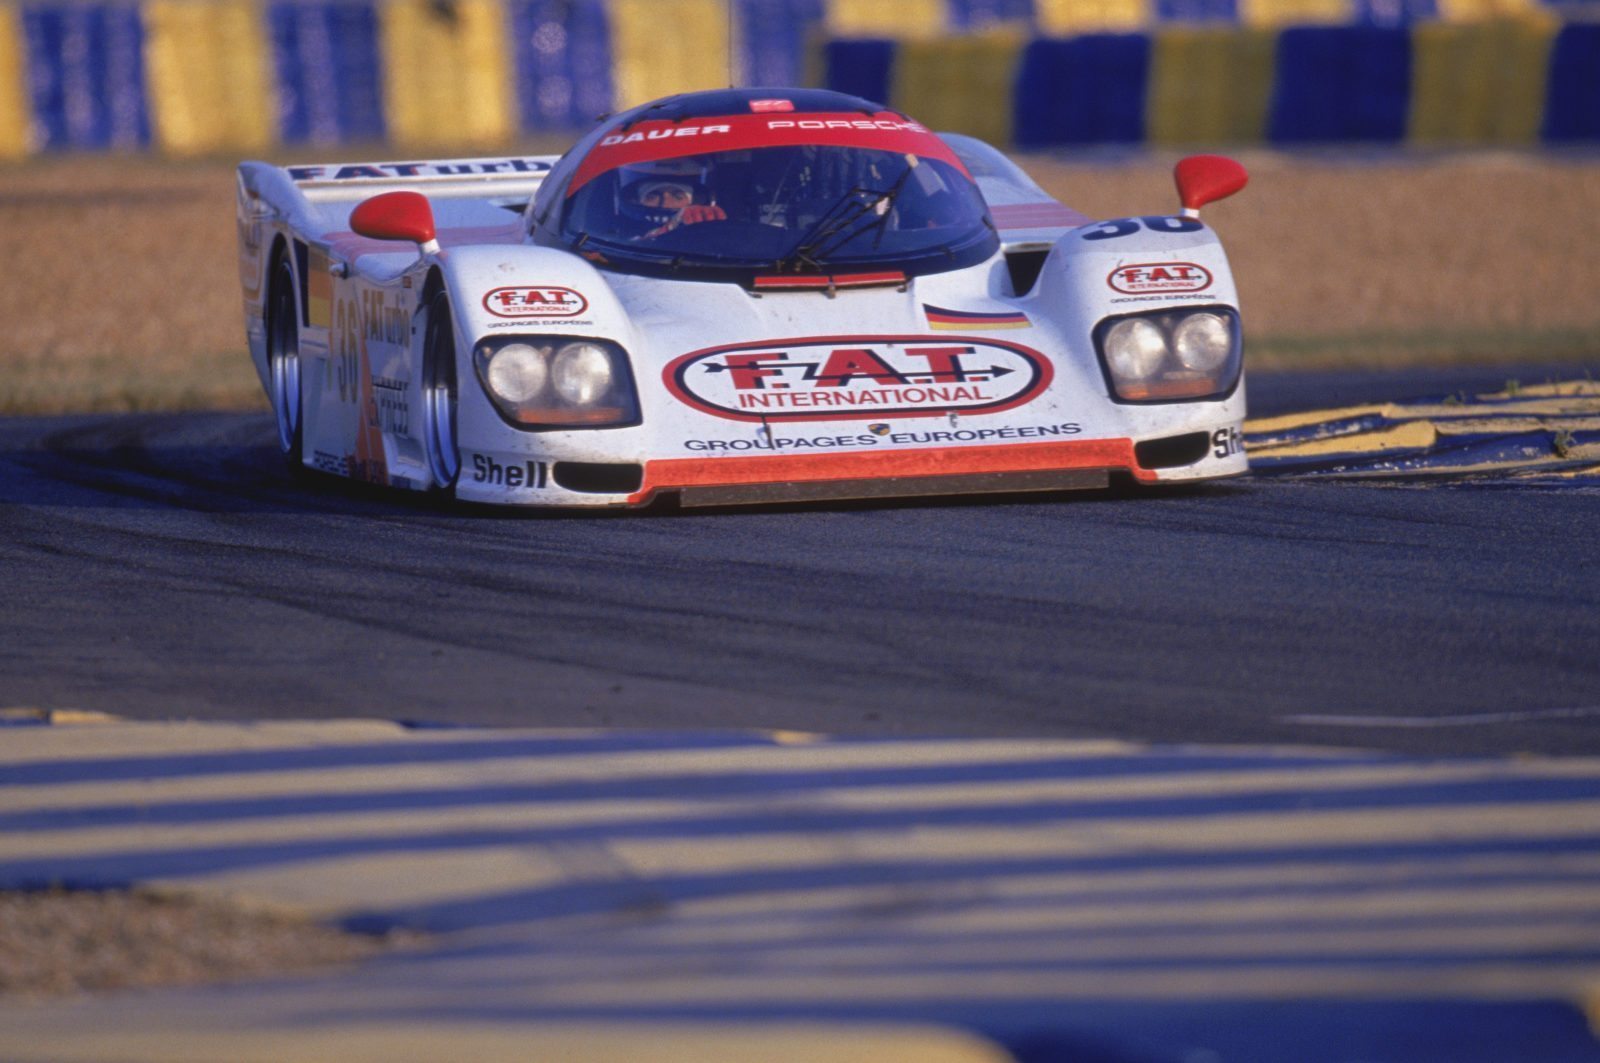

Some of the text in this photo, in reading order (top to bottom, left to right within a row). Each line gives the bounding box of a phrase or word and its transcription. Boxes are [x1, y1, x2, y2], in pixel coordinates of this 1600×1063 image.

[600, 120, 928, 146] DAUER PORSCHE
[503, 305, 571, 313] INTERNATIONAL
[738, 385, 993, 408] INTERNATIONAL
[684, 422, 1083, 452] GROUPAGES EUROPÉENS
[472, 453, 547, 489] Shell
